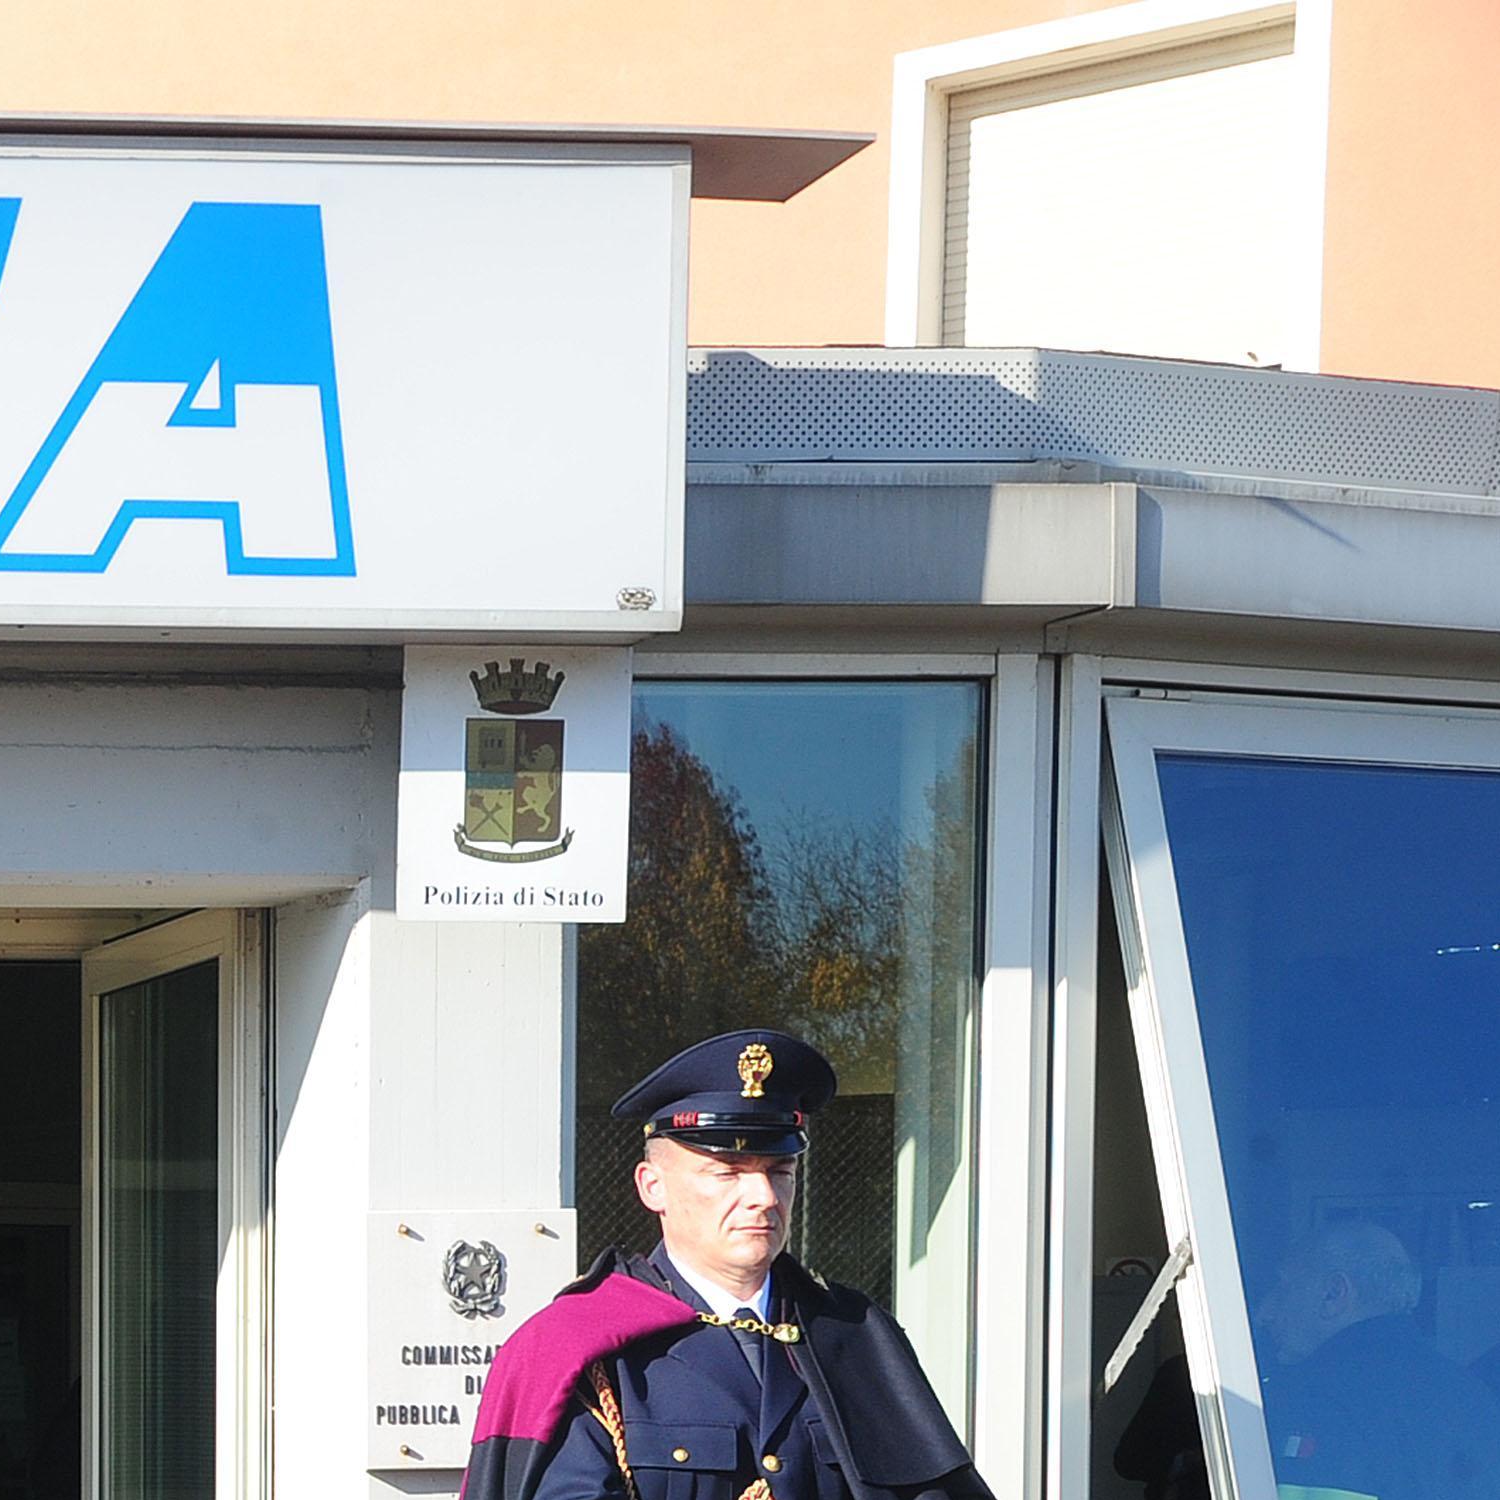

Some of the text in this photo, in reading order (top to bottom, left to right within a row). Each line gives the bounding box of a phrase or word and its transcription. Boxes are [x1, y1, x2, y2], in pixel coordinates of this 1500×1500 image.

[423, 885, 604, 907] Polizia di Stato
[401, 1345, 502, 1366] COMMISSA
[375, 1405, 461, 1426] PUBBLICA
